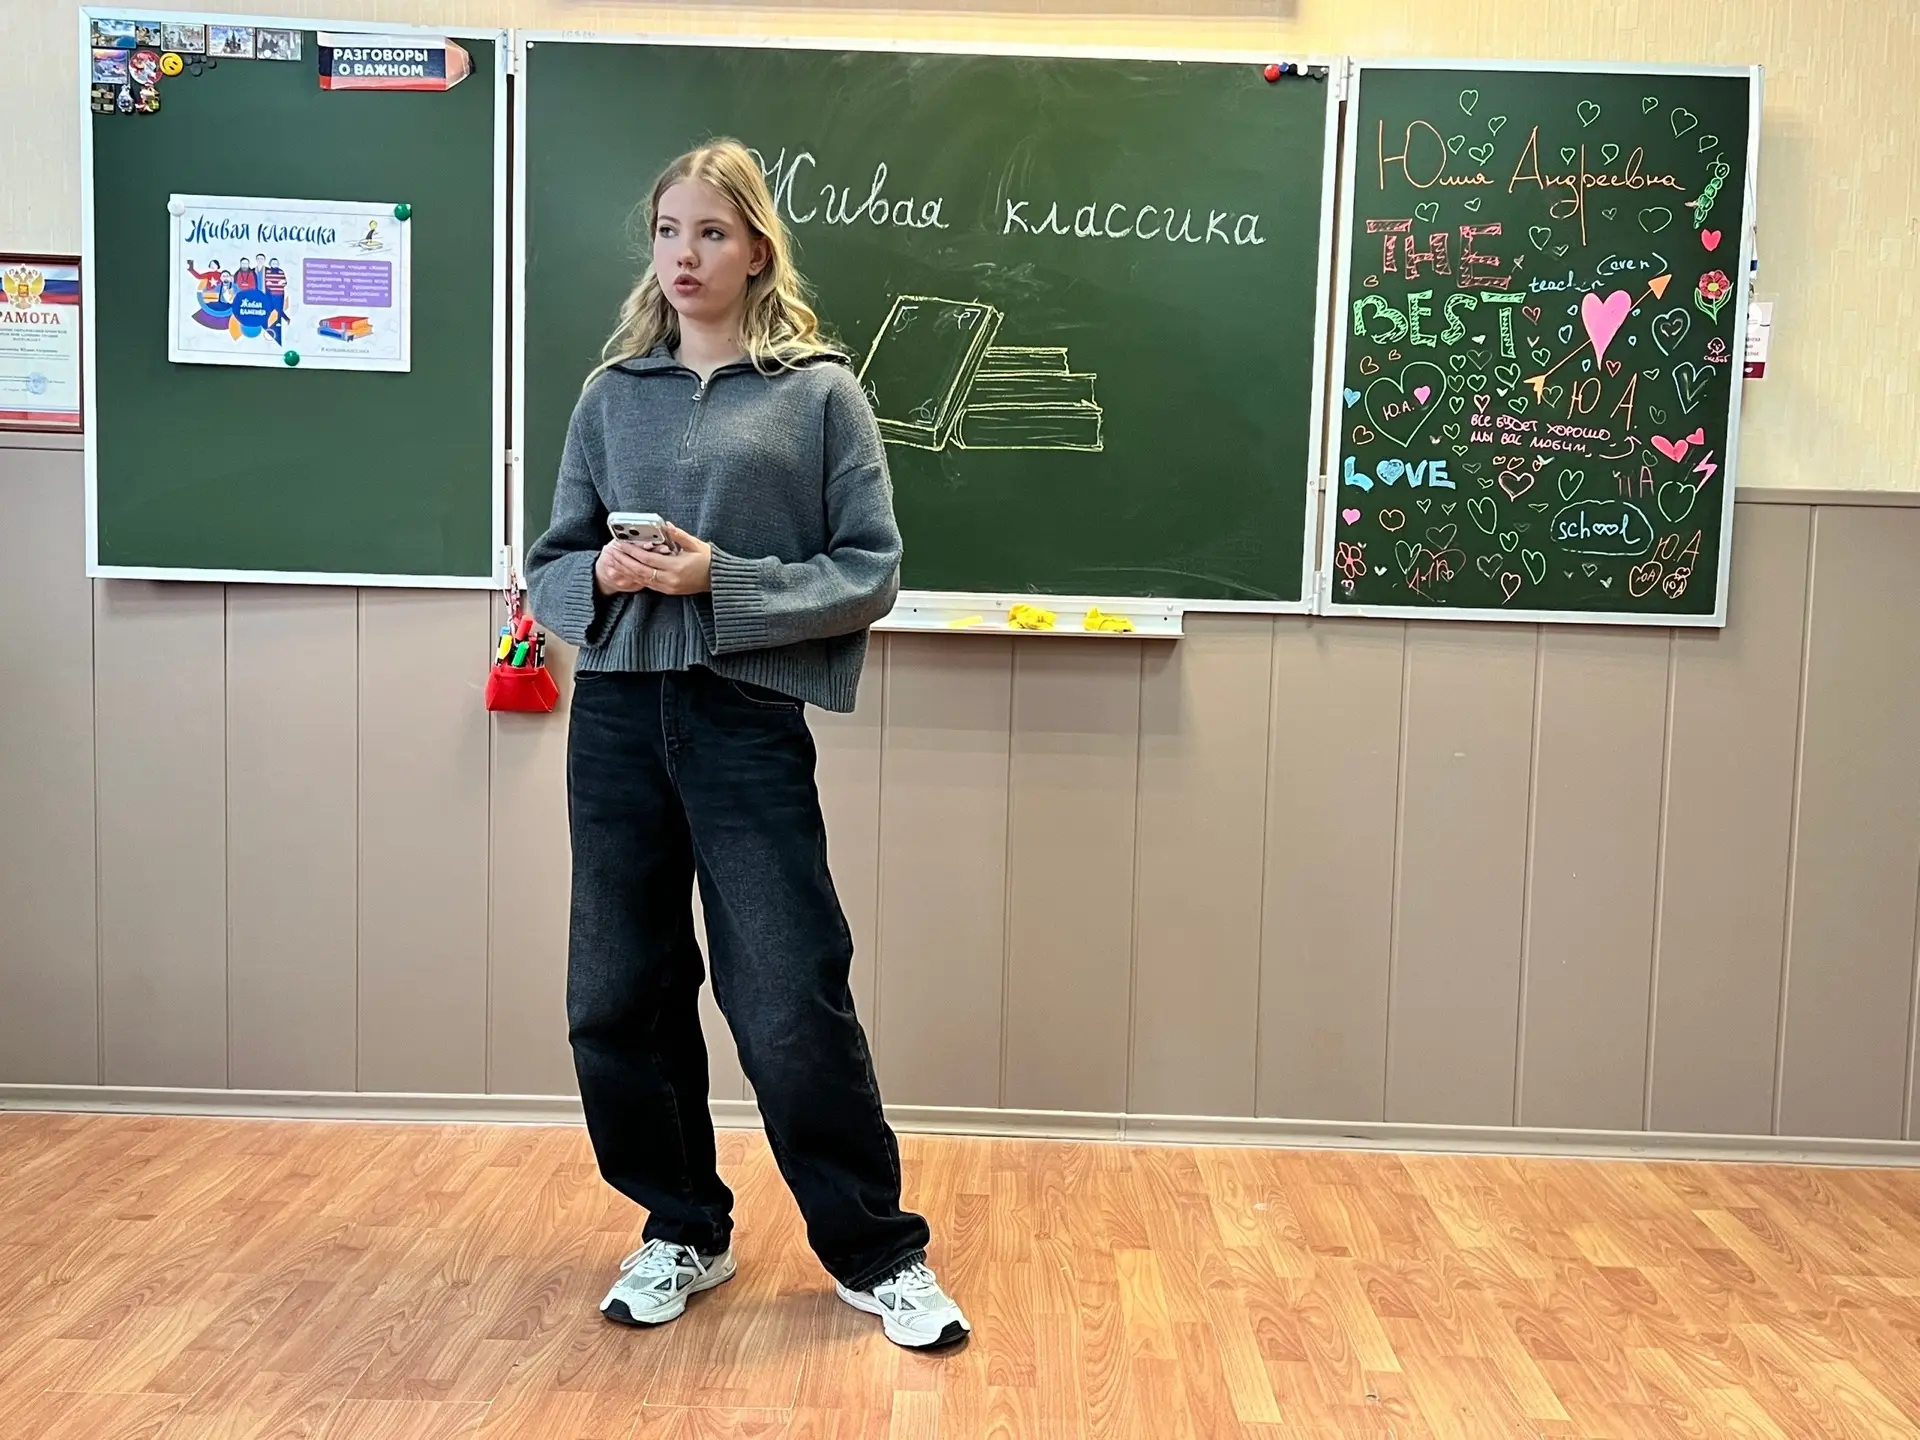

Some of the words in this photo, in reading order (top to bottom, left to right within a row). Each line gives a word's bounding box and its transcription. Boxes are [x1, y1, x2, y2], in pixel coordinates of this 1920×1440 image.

[333, 48, 429, 62] РАЗГОВОРЫ
[338, 63, 351, 76] О
[353, 64, 424, 77] ВАЖНОМ
[1378, 119, 1495, 191] Юлия
[1508, 125, 1686, 246] Андреевна
[184, 213, 251, 245] Живая
[256, 222, 337, 246] классика
[1002, 197, 1267, 245] классика
[1365, 218, 1512, 290] THE
[0, 311, 61, 325] АМОТА
[1353, 289, 1527, 359] BEST
[1344, 455, 1456, 493] LOVE
[1557, 510, 1641, 545] school
